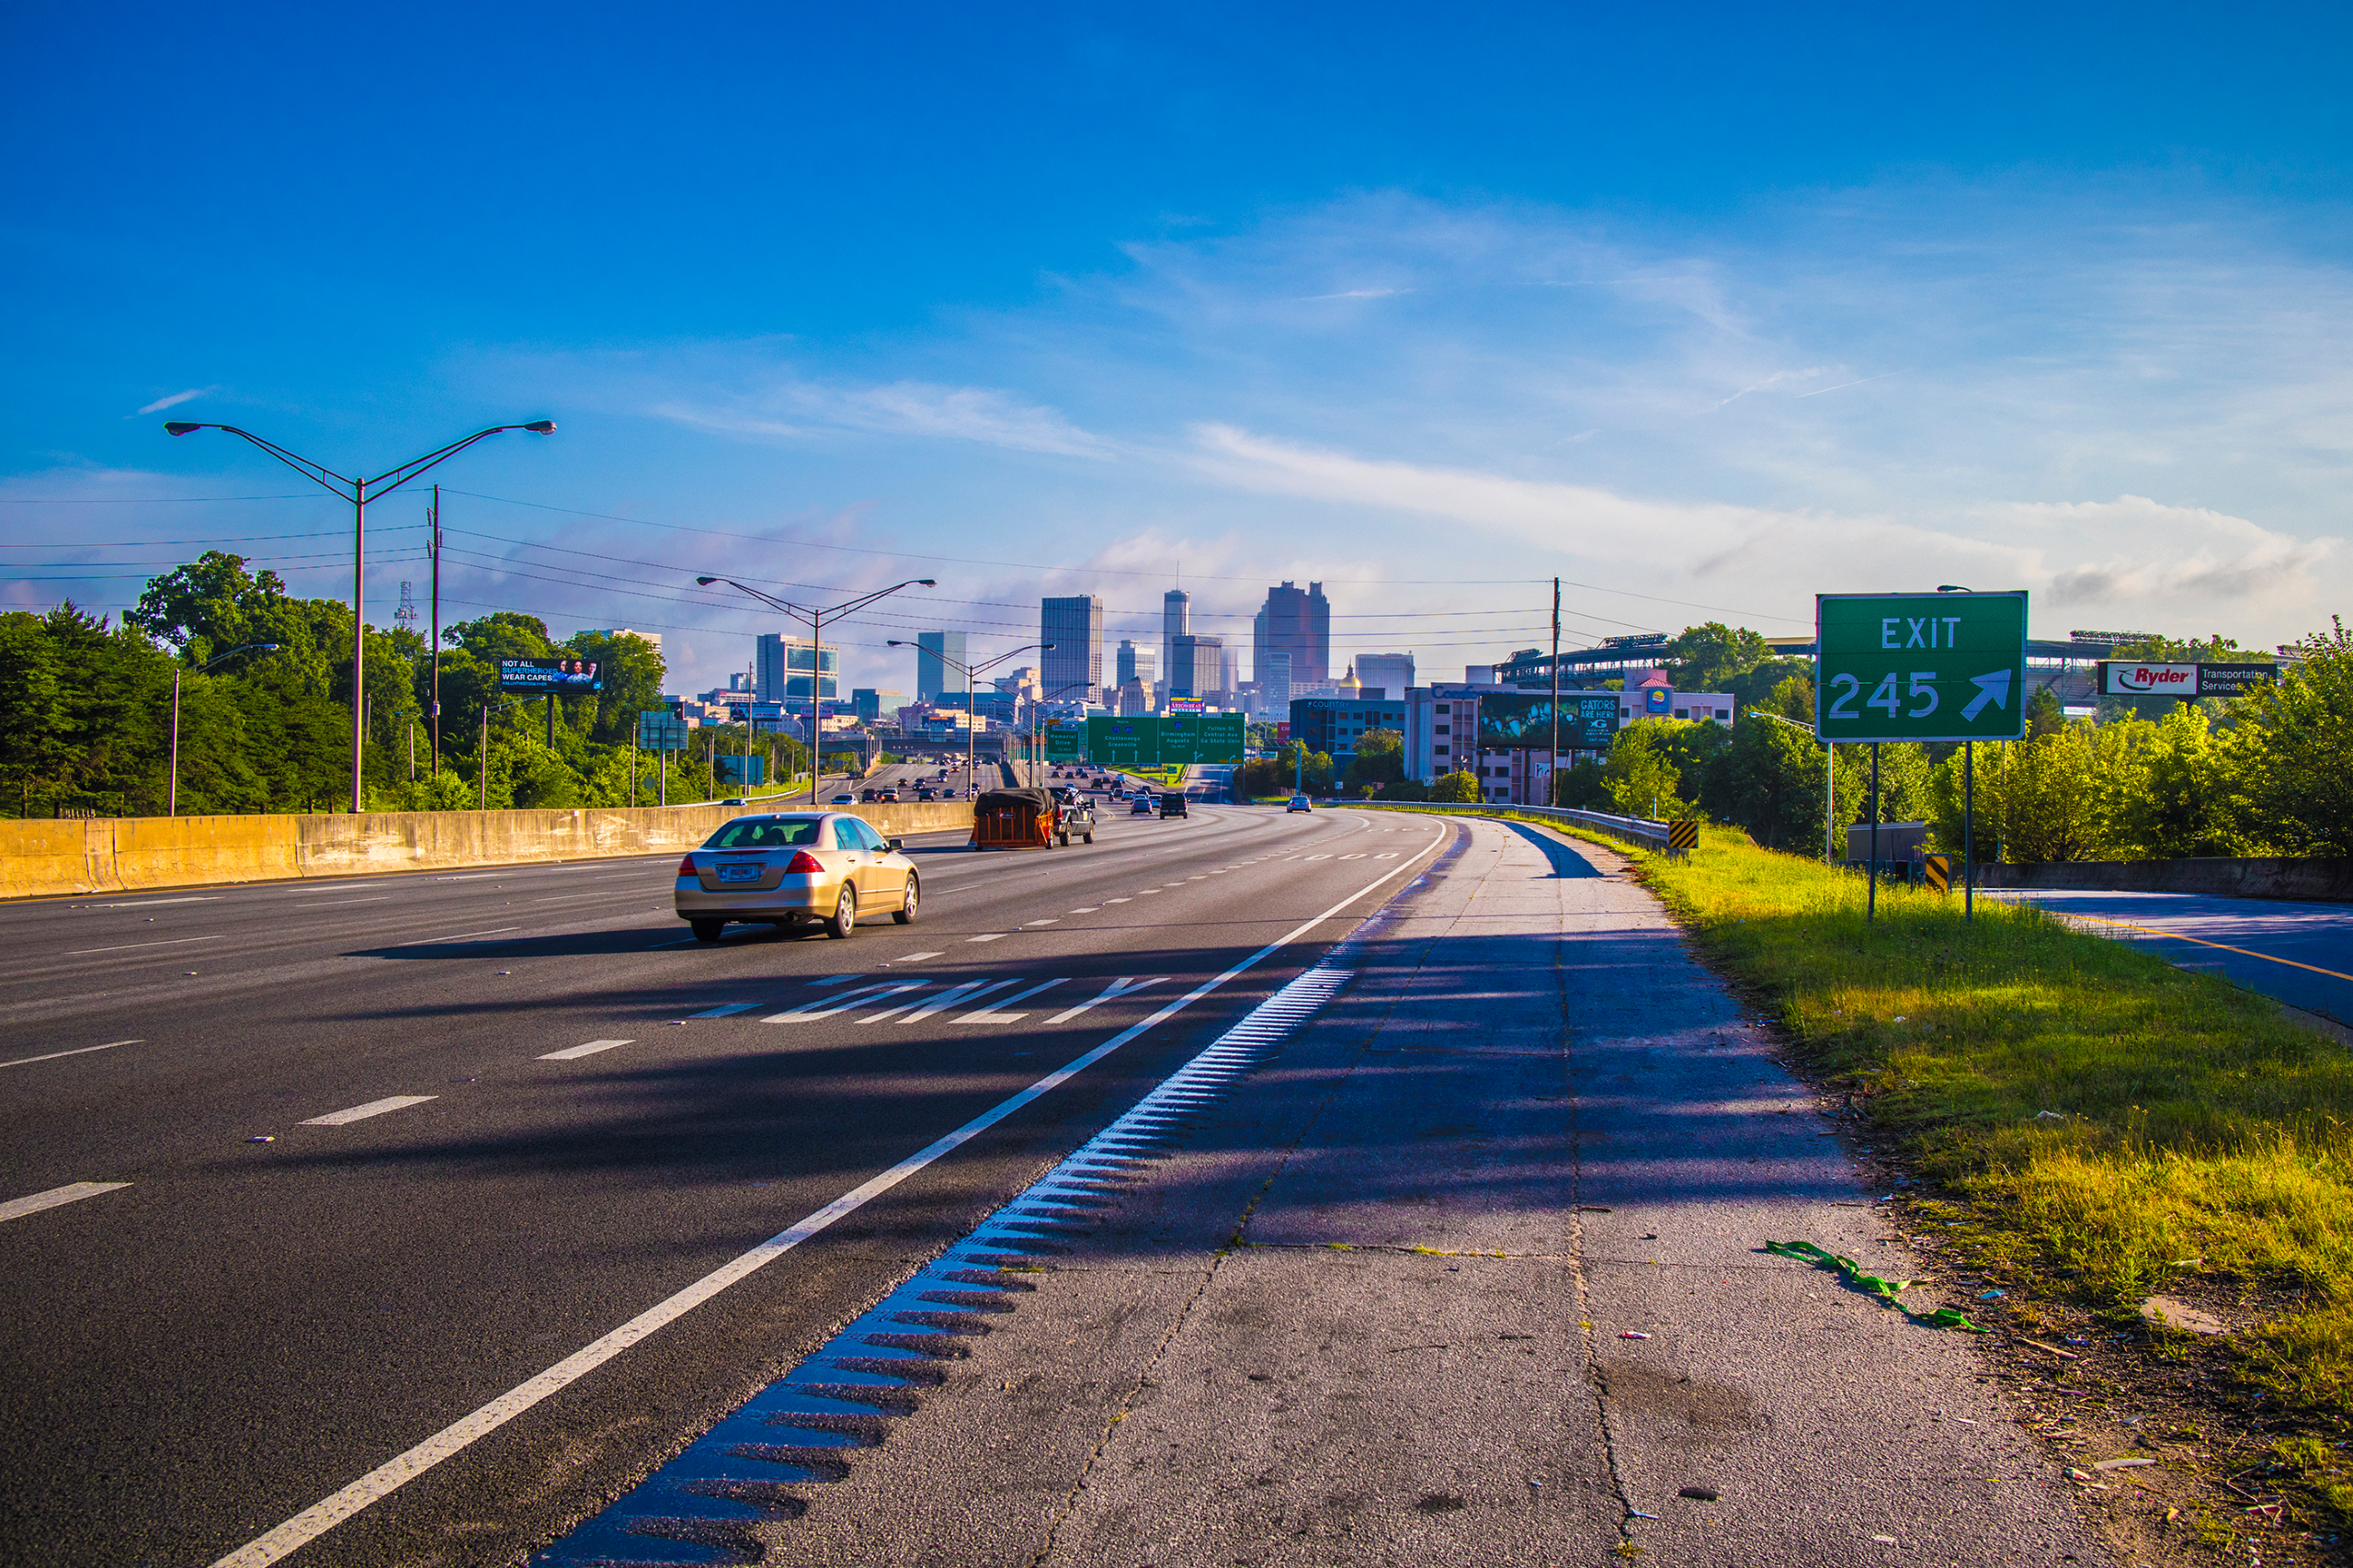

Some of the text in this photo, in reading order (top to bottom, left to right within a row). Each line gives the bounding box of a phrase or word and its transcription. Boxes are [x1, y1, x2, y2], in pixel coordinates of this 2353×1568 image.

[1881, 617, 1961, 649] EXIT
[502, 660, 518, 668] NOT
[2134, 667, 2189, 687] Ryder
[2201, 668, 2268, 680] Transportation
[2201, 681, 2241, 691] Service
[1828, 672, 1939, 719] 245
[1581, 699, 1616, 710] GATORS
[1581, 710, 1615, 719] ARE HERE
[760, 976, 1171, 1024] ONLY
